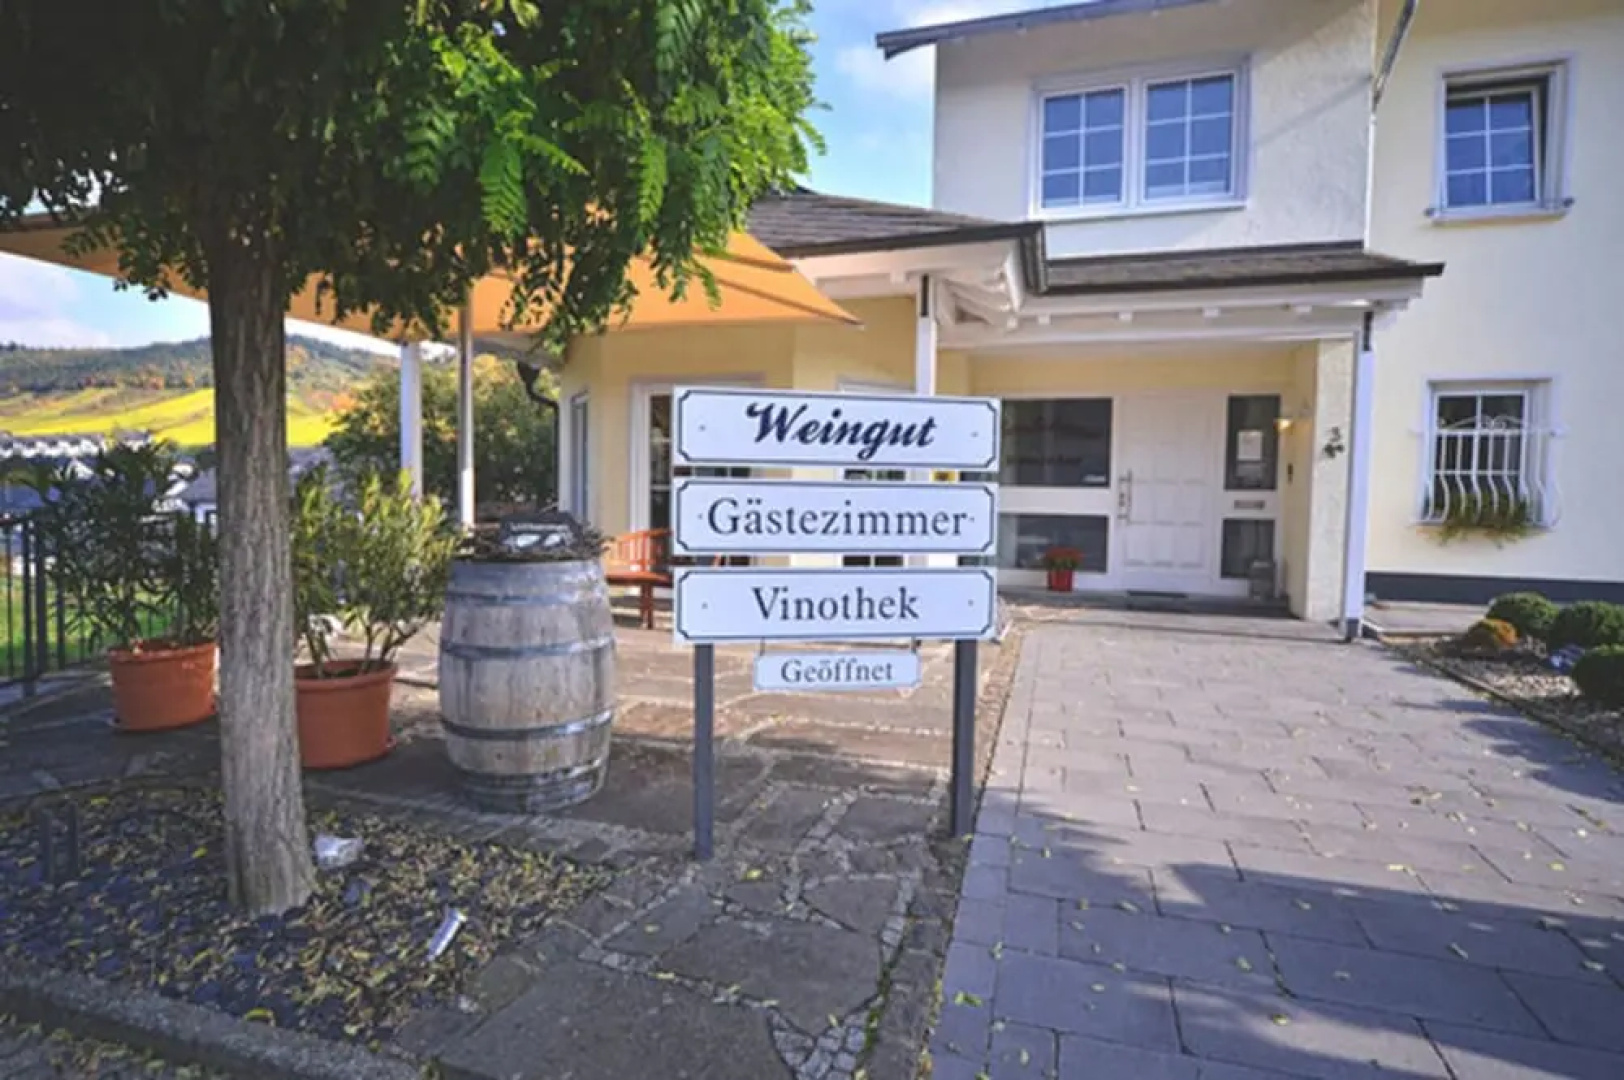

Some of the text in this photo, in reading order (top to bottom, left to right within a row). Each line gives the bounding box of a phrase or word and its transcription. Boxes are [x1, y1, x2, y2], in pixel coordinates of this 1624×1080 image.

[745, 402, 937, 460] Weingut
[707, 497, 967, 536] Gästezimmer
[752, 586, 920, 621] Vinothek
[780, 657, 894, 684] Geöffnet
